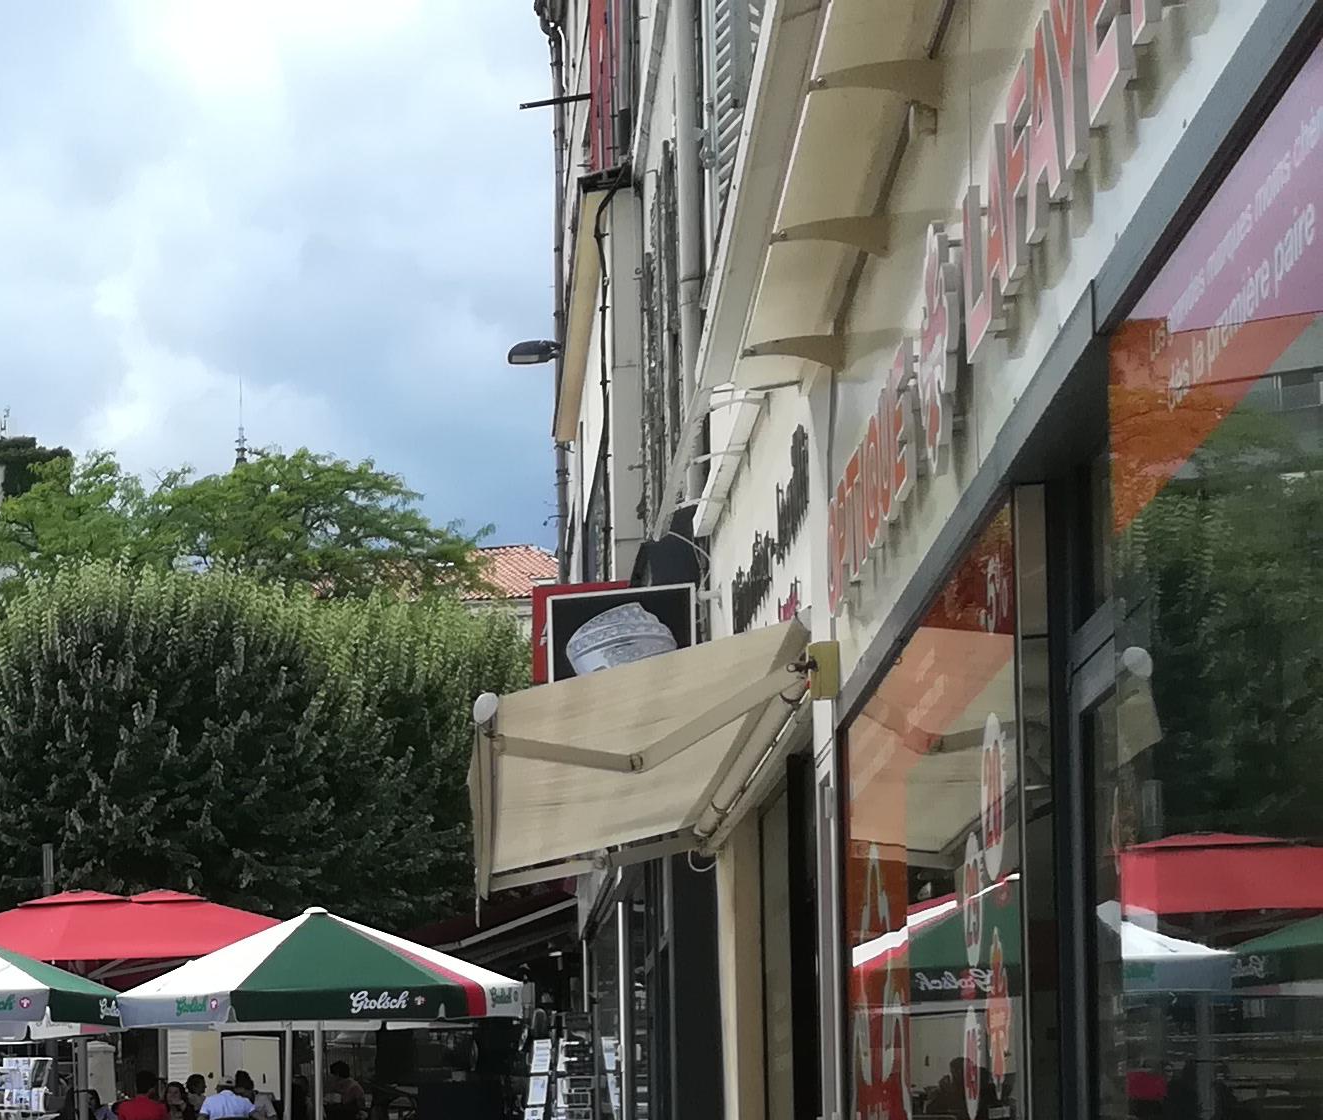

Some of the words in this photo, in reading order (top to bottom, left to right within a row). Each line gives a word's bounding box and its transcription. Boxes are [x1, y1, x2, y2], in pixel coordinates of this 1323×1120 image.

[962, 0, 1150, 364] LAFAYE
[1254, 152, 1291, 222] moins
[1191, 335, 1205, 383] la
[1206, 262, 1271, 376] première
[1274, 203, 1316, 298] paire
[827, 340, 908, 618] OPTIQUE
[350, 990, 410, 1014] Grolsch
